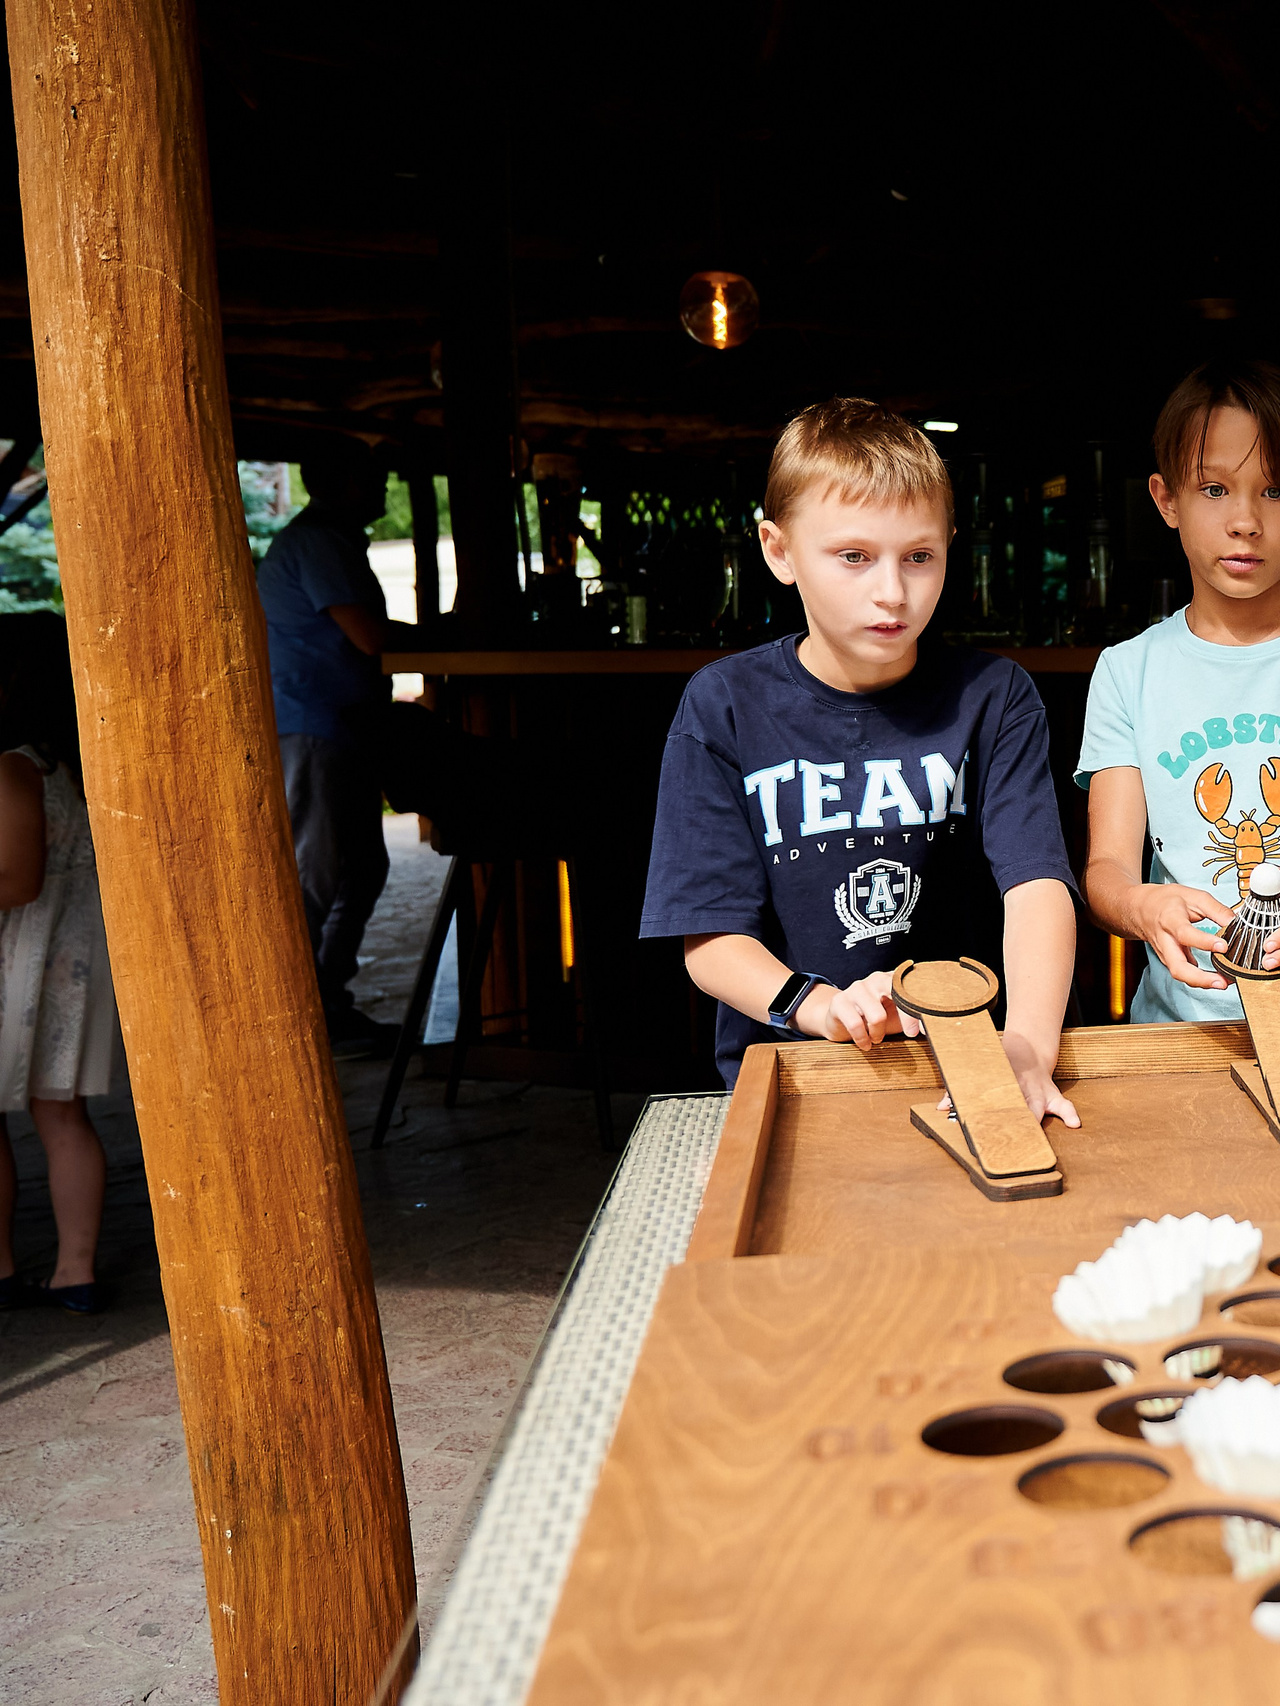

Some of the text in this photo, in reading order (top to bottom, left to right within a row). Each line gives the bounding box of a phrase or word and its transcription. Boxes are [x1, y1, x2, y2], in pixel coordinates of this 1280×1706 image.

[743, 749, 969, 847] TEAM
[773, 824, 956, 865] ADVENTUE
[865, 873, 897, 914] A
